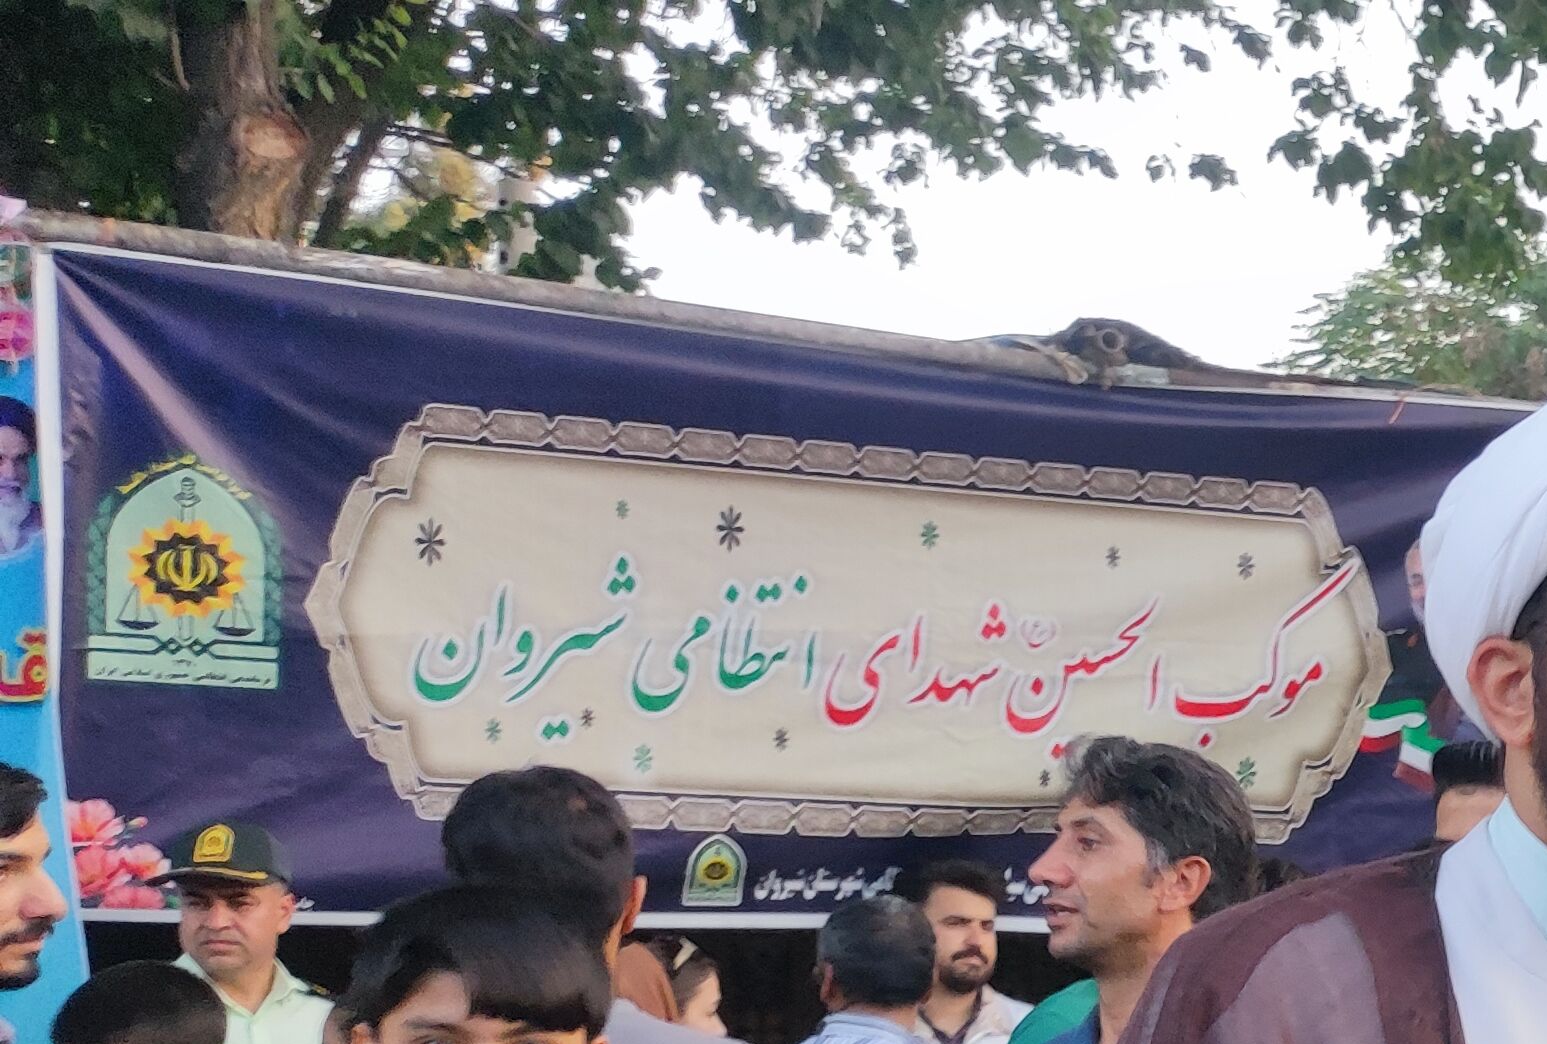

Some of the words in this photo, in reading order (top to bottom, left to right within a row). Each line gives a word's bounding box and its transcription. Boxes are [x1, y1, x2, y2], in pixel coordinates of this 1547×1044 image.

[413, 557, 637, 740] شیروان
[630, 577, 816, 713] انتظامی
[823, 604, 1008, 729] شهدای
[1004, 599, 1163, 760] الحسین
[1172, 558, 1361, 748] موکب
